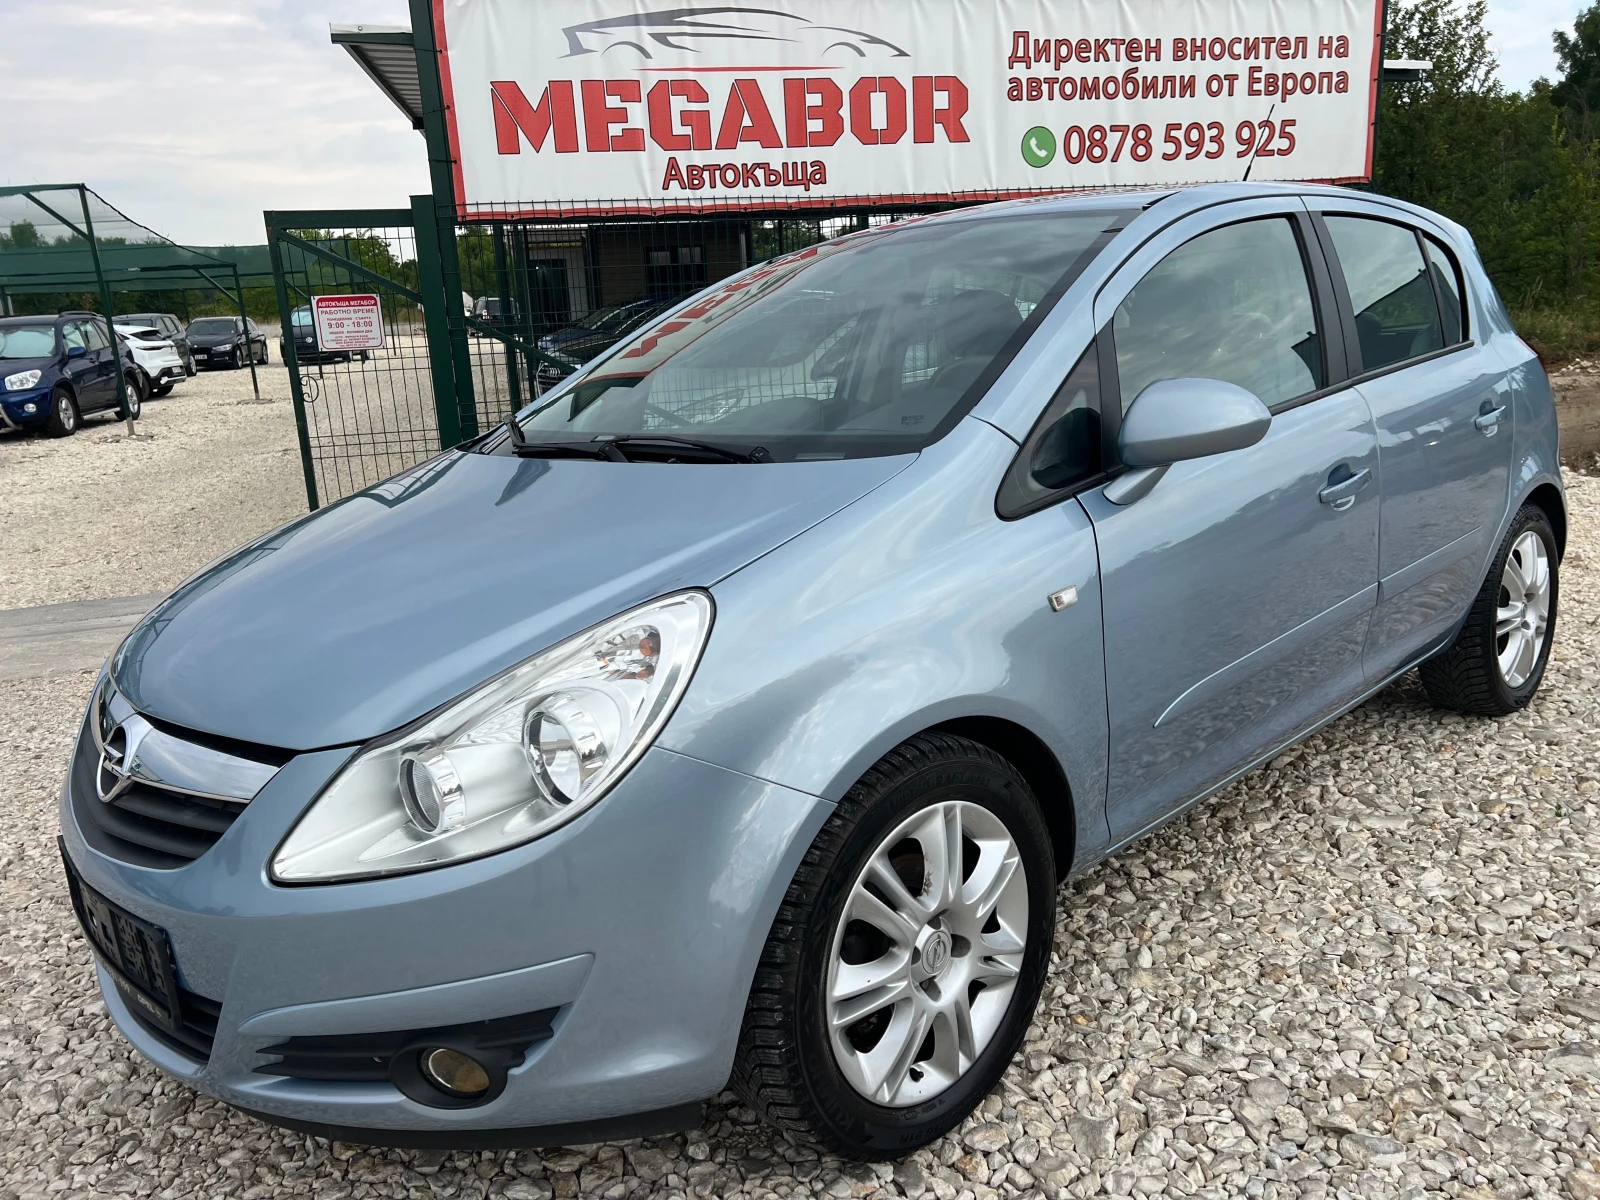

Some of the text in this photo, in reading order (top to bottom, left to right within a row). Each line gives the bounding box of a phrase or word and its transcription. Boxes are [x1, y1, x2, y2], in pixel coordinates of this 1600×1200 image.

[1008, 30, 1349, 71] Директен вносител на
[1007, 66, 1349, 102] автомобили от Европа
[490, 76, 970, 155] MEGABOR
[1063, 119, 1296, 164] 0878 593 925
[662, 157, 827, 191] Автокъща
